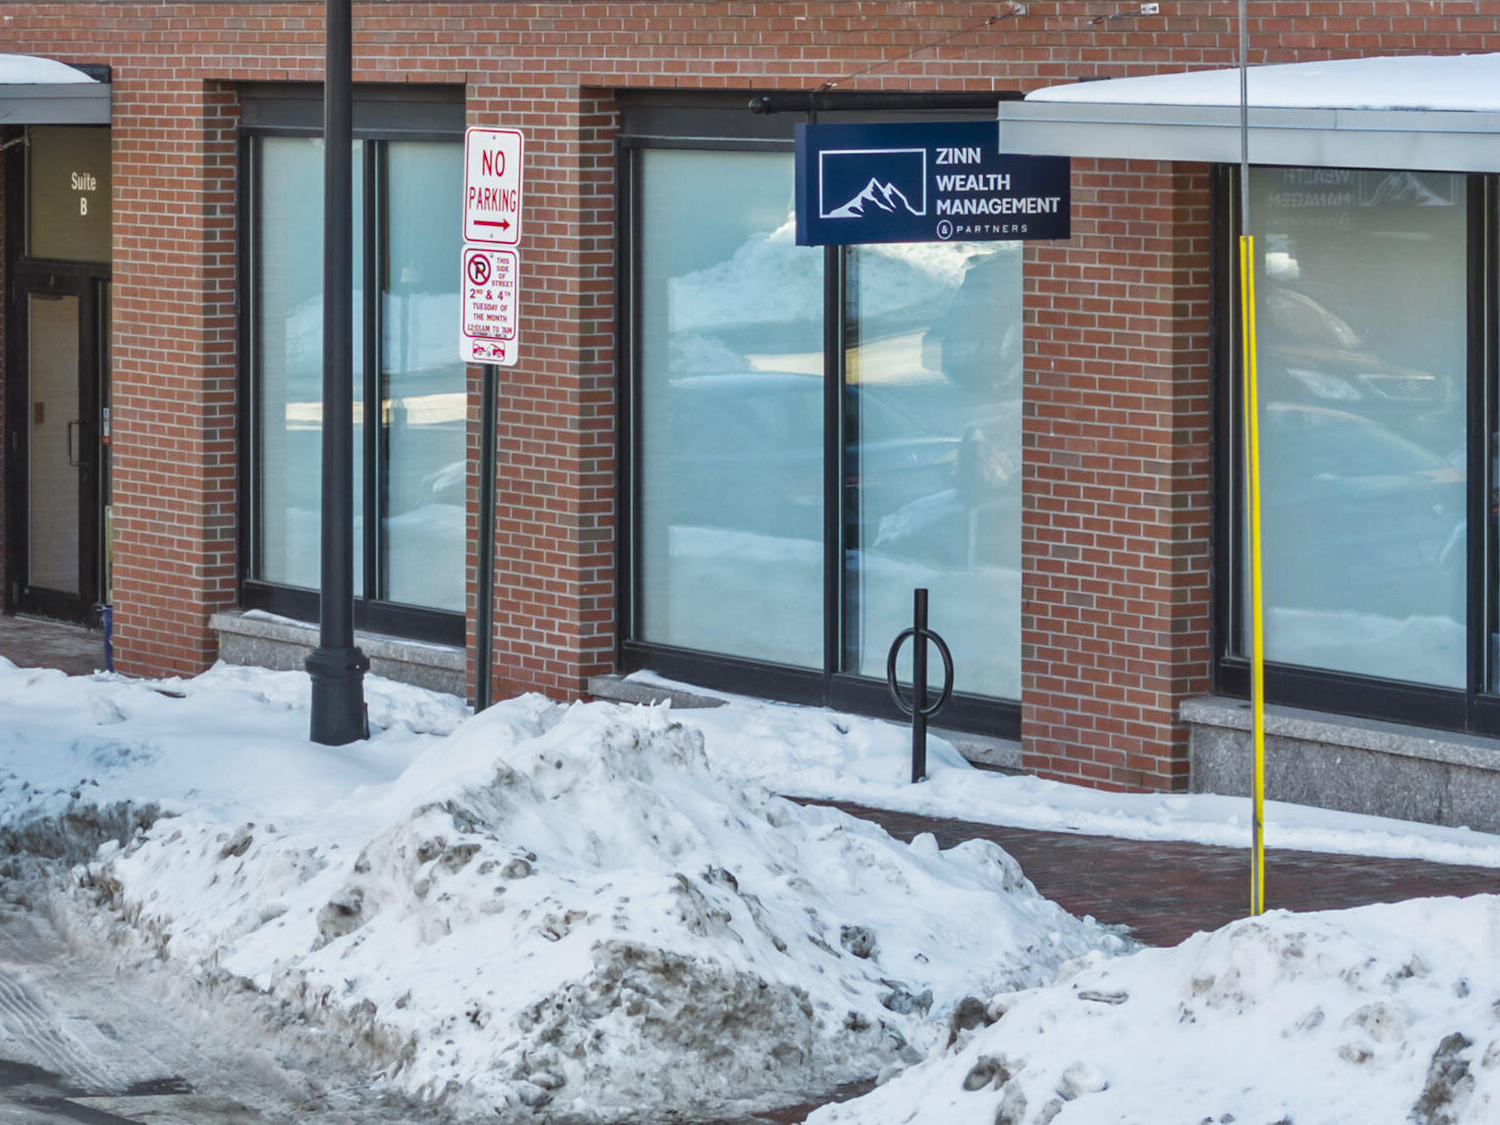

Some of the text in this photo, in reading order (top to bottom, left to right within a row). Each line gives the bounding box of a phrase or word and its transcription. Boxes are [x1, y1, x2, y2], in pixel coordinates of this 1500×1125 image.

[935, 147, 981, 165] ZINN
[482, 149, 506, 178] NO
[71, 171, 97, 192] Suite
[936, 174, 1011, 192] WEALTH
[469, 186, 517, 213] PARKING
[80, 197, 88, 216] B
[936, 197, 1061, 216] MANAGEMENT
[956, 224, 1029, 234] PARTNERS
[496, 257, 510, 265] THIS
[496, 265, 509, 273] SIDE
[491, 280, 514, 288] STREET
[485, 289, 493, 300] &
[472, 302, 508, 312] TUESDAY OF
[473, 313, 508, 323] THE MONTH
[492, 325, 500, 334] TO
